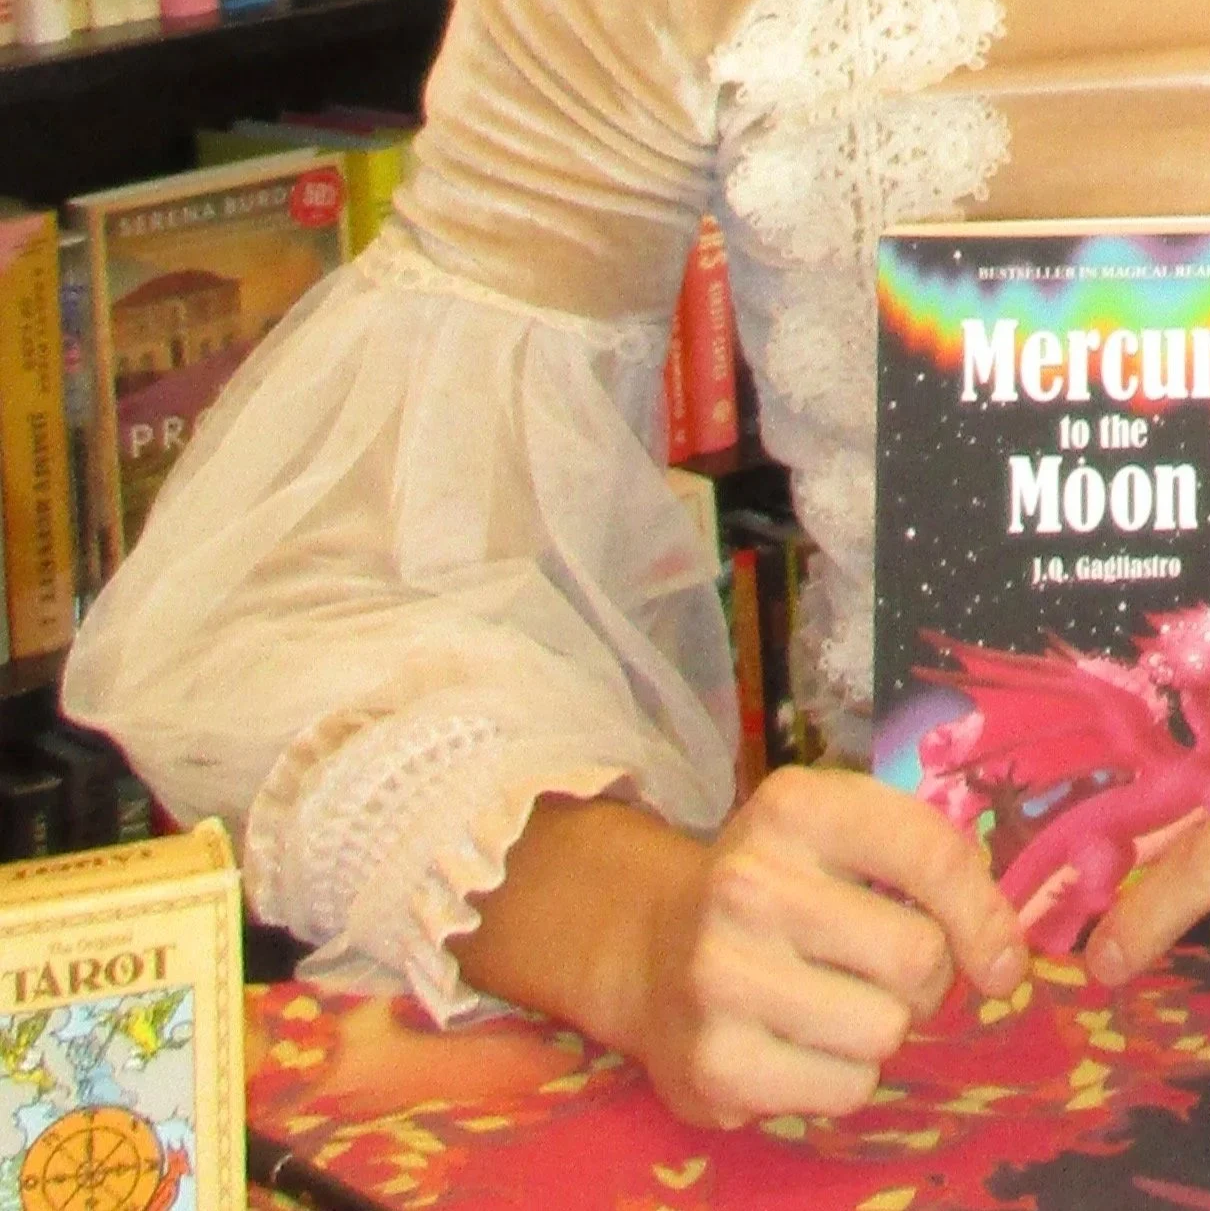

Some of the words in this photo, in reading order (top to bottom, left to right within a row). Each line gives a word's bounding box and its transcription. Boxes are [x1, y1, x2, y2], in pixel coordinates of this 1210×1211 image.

[119, 202, 217, 238] SERENA
[224, 186, 294, 218] BURD
[977, 266, 1076, 281] BESTSELLER
[1078, 265, 1099, 279] IN
[1101, 264, 1170, 279] MAGICAL
[1059, 415, 1091, 450] to
[1098, 414, 1149, 449] the
[1007, 453, 1199, 535] Moon
[1031, 558, 1070, 585] J.Q.
[1075, 554, 1182, 582] Gagliastro
[2, 942, 178, 1005] TAROT
